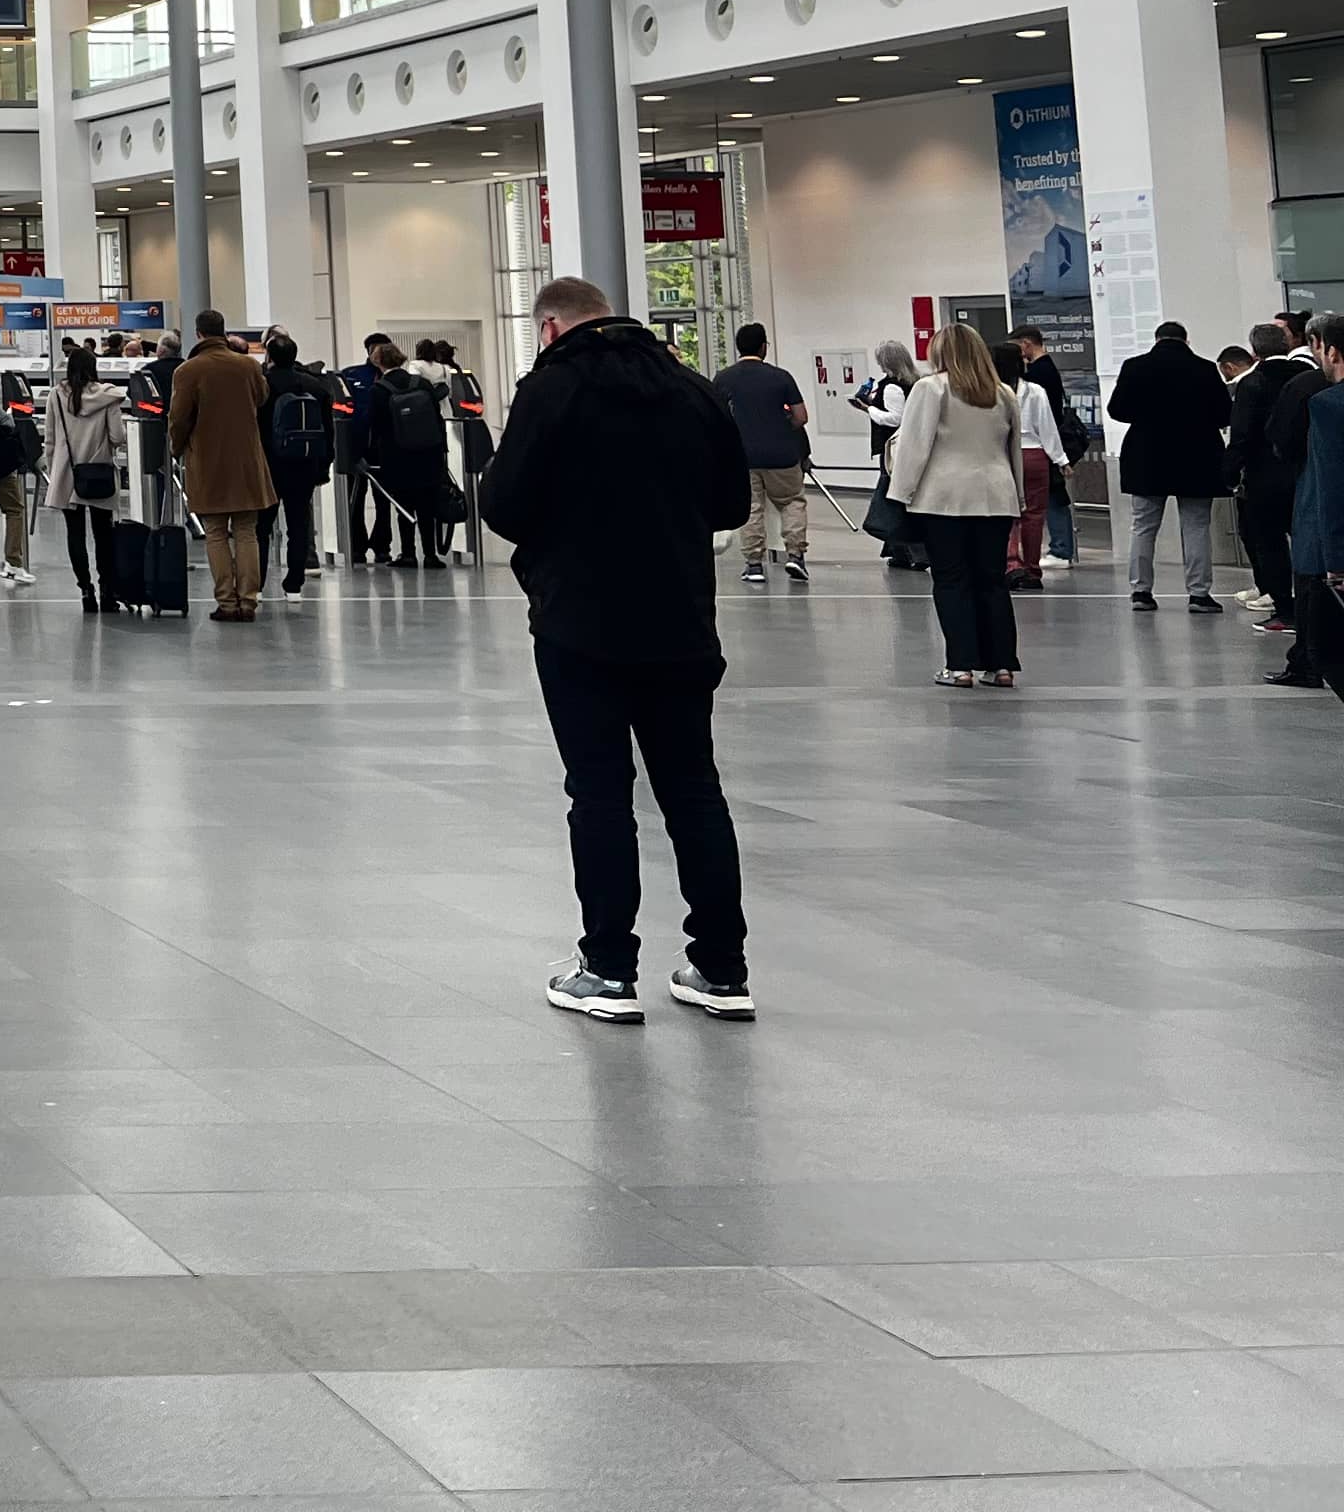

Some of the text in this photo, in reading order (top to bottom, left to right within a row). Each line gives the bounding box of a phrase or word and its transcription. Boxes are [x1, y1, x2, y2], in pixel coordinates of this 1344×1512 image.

[1014, 149, 1069, 169] Trusted by
[1016, 174, 1068, 192] benefiting
[664, 184, 698, 193] Halls A
[57, 306, 100, 315] GET YOUR
[57, 316, 115, 325] EVENT GUIDE
